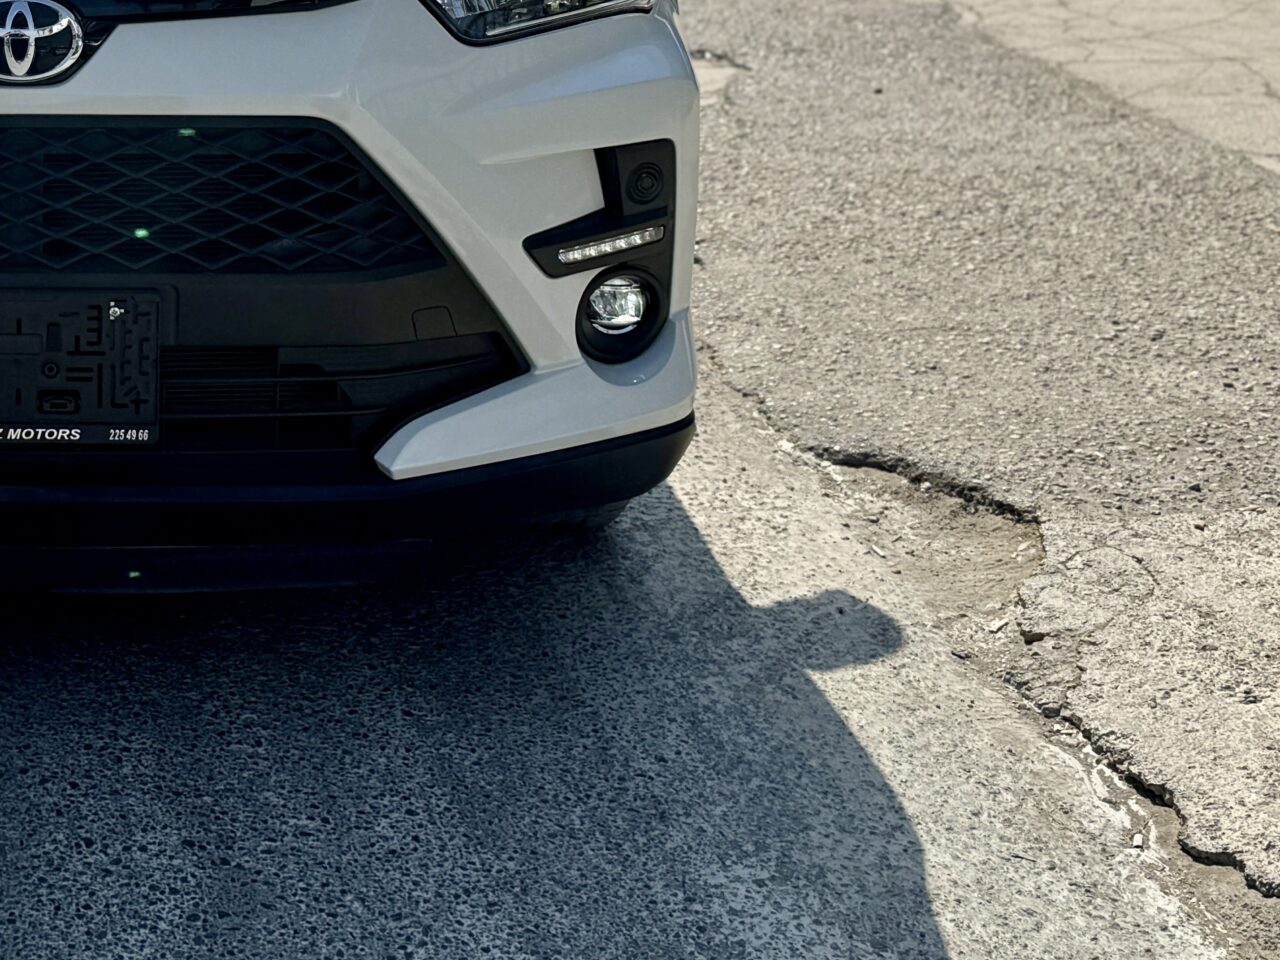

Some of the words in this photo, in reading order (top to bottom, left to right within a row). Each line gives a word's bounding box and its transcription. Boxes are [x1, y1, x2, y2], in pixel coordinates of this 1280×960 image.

[6, 428, 81, 440] MOTORS
[109, 429, 125, 441] 225
[126, 429, 137, 441] 49
[138, 429, 149, 441] 66
